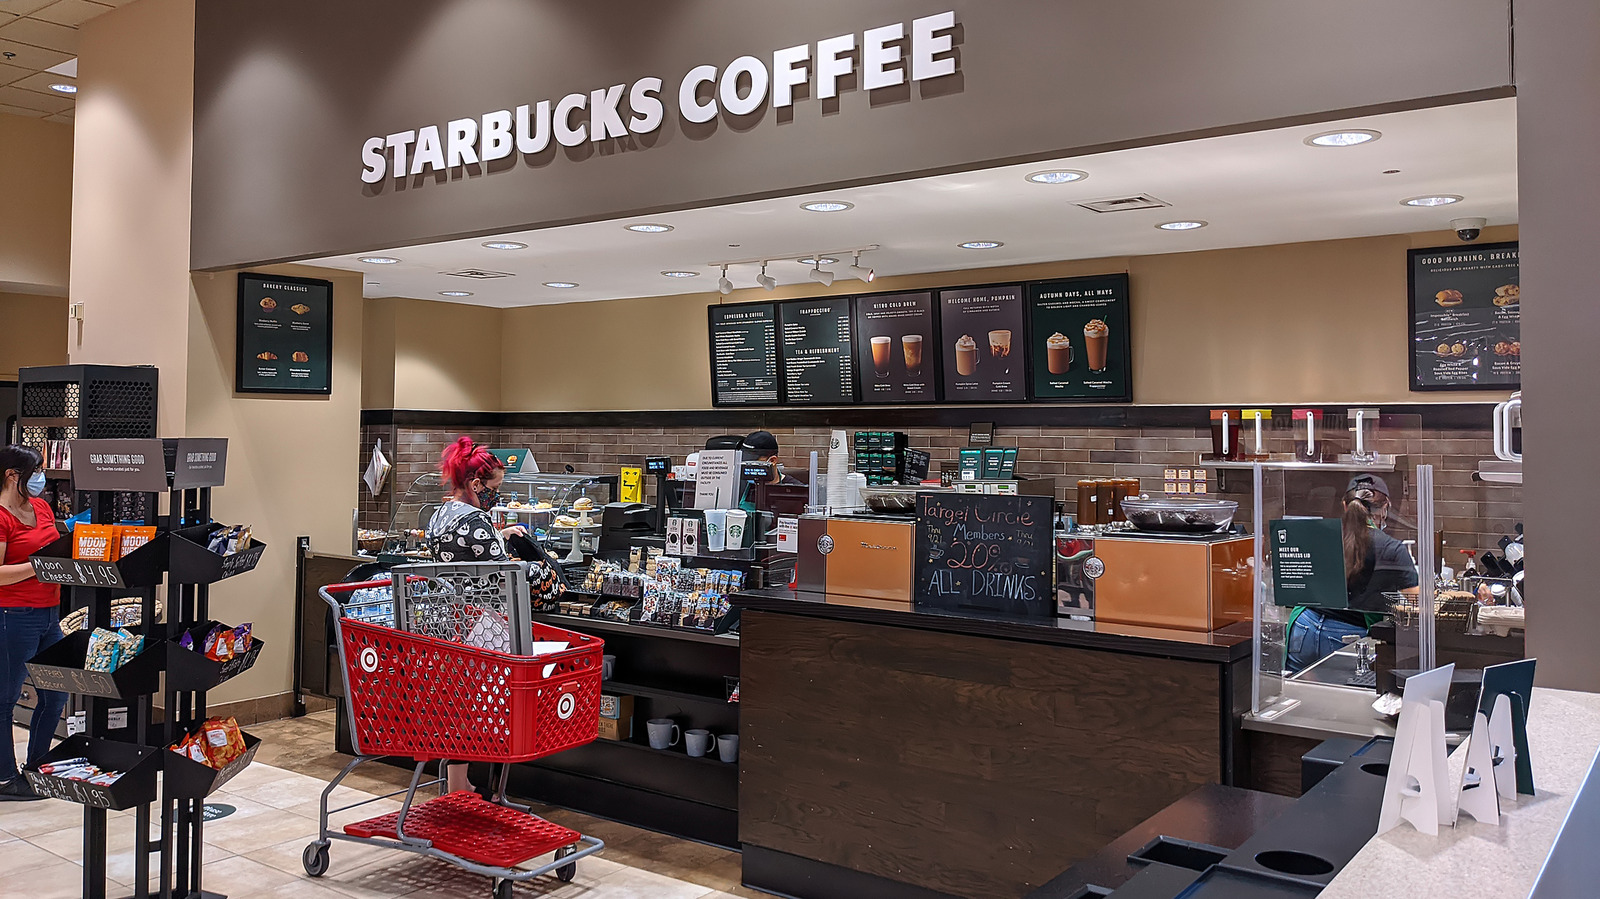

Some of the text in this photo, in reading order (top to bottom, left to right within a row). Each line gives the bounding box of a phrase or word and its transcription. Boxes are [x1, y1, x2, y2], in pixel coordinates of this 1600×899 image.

[361, 10, 956, 183] STARBUCKS COFFEE
[1421, 257, 1443, 265] GOOD
[1446, 253, 1486, 264] MORNING,
[90, 454, 145, 465] GRAB SOMETHING GOOD
[920, 495, 1034, 526] Target Circle
[926, 524, 942, 535] Thru
[953, 523, 1006, 540] Members
[78, 536, 107, 548] MOON
[78, 547, 105, 557] CHEESE
[33, 559, 64, 570] Moon
[41, 571, 75, 583] Cheese
[74, 561, 118, 586] $4.95
[927, 569, 1036, 601] ALL DRINKS
[29, 663, 65, 679] Buttered
[34, 783, 52, 798] Fruit
[72, 781, 111, 808] $1.95
